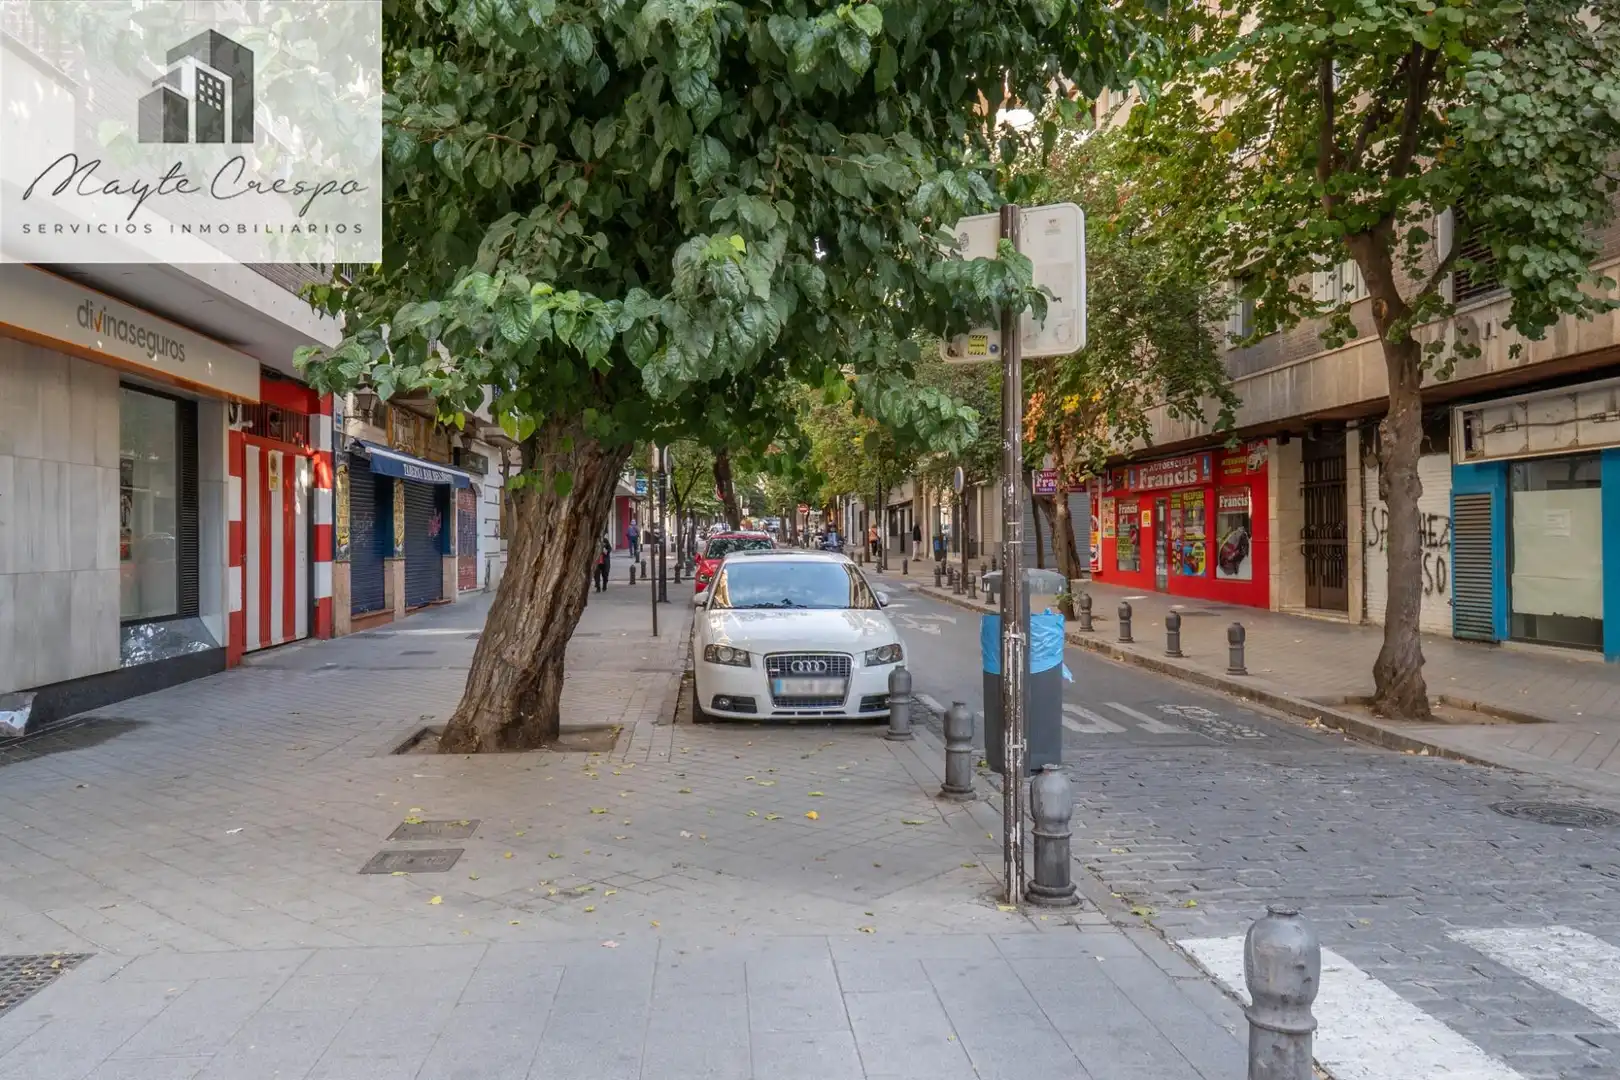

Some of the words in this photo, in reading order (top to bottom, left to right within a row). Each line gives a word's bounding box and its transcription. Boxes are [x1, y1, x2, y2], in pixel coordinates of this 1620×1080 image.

[76, 298, 186, 363] divinaseguros
[1149, 456, 1197, 473] AUTOESCUELA
[1368, 506, 1451, 552] SAHEZ
